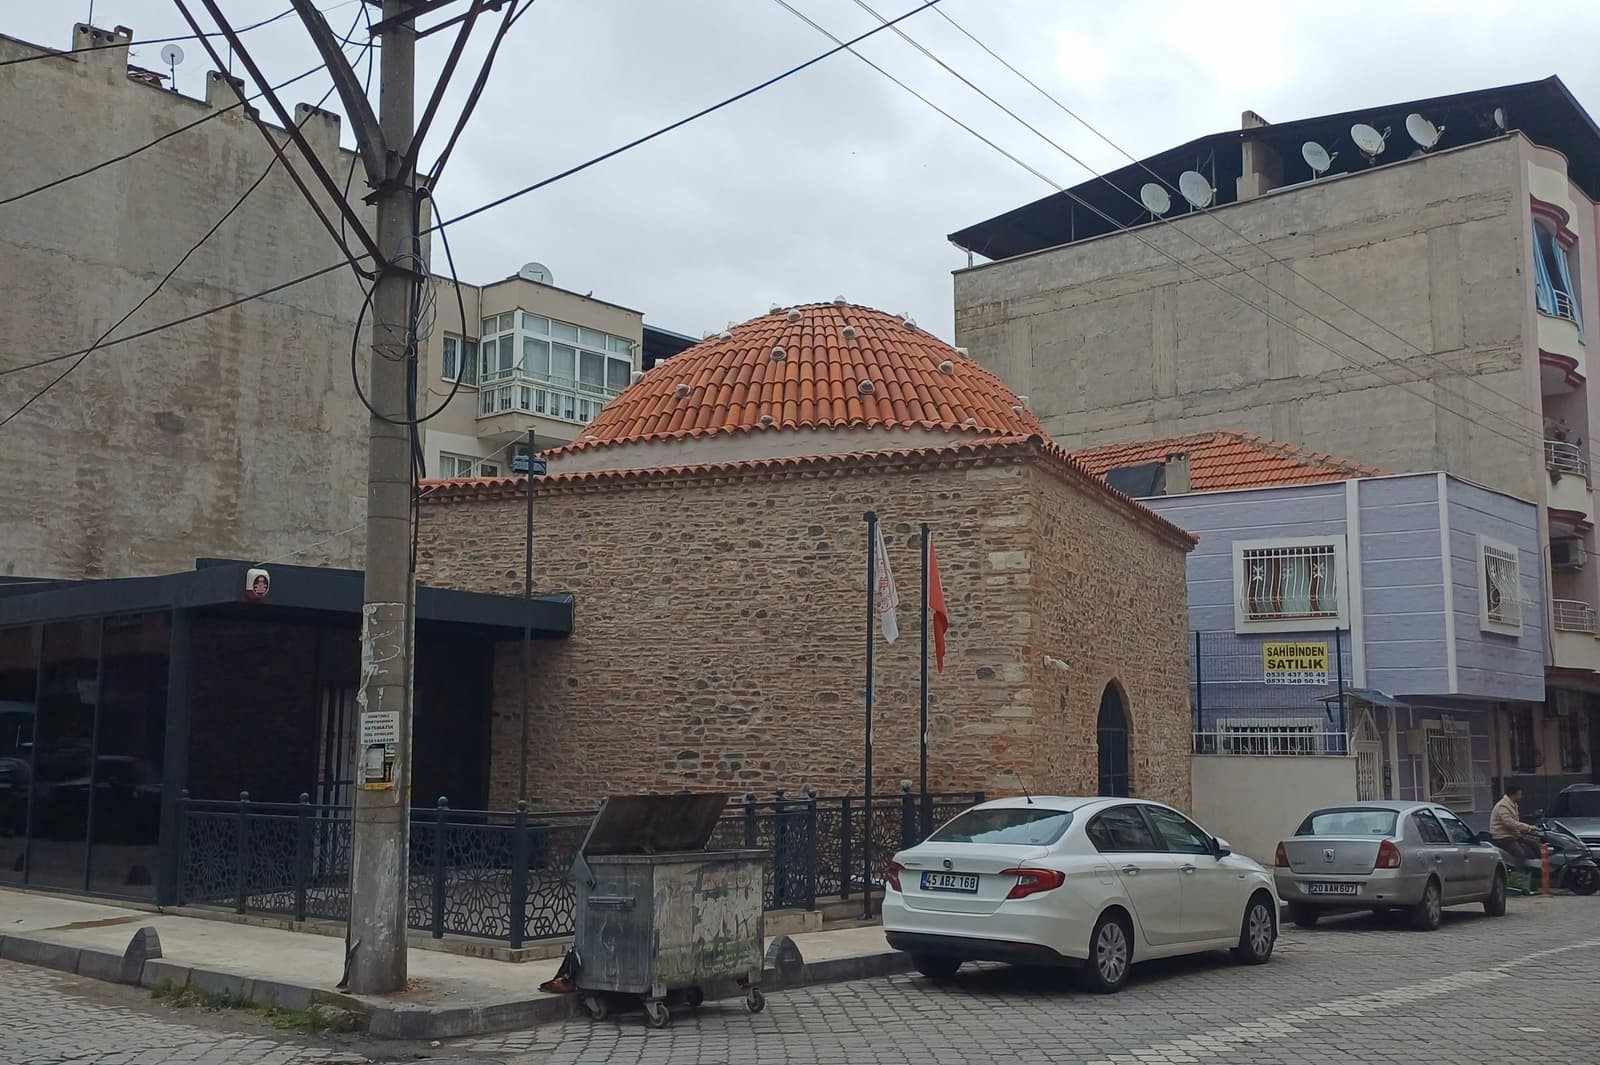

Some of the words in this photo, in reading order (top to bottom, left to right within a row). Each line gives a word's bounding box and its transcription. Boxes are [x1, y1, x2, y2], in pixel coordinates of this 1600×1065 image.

[1267, 645, 1324, 656] SAHİBİNDEN
[1267, 659, 1324, 669] SATILIK
[927, 873, 937, 885] 45
[939, 875, 956, 887] ABZ
